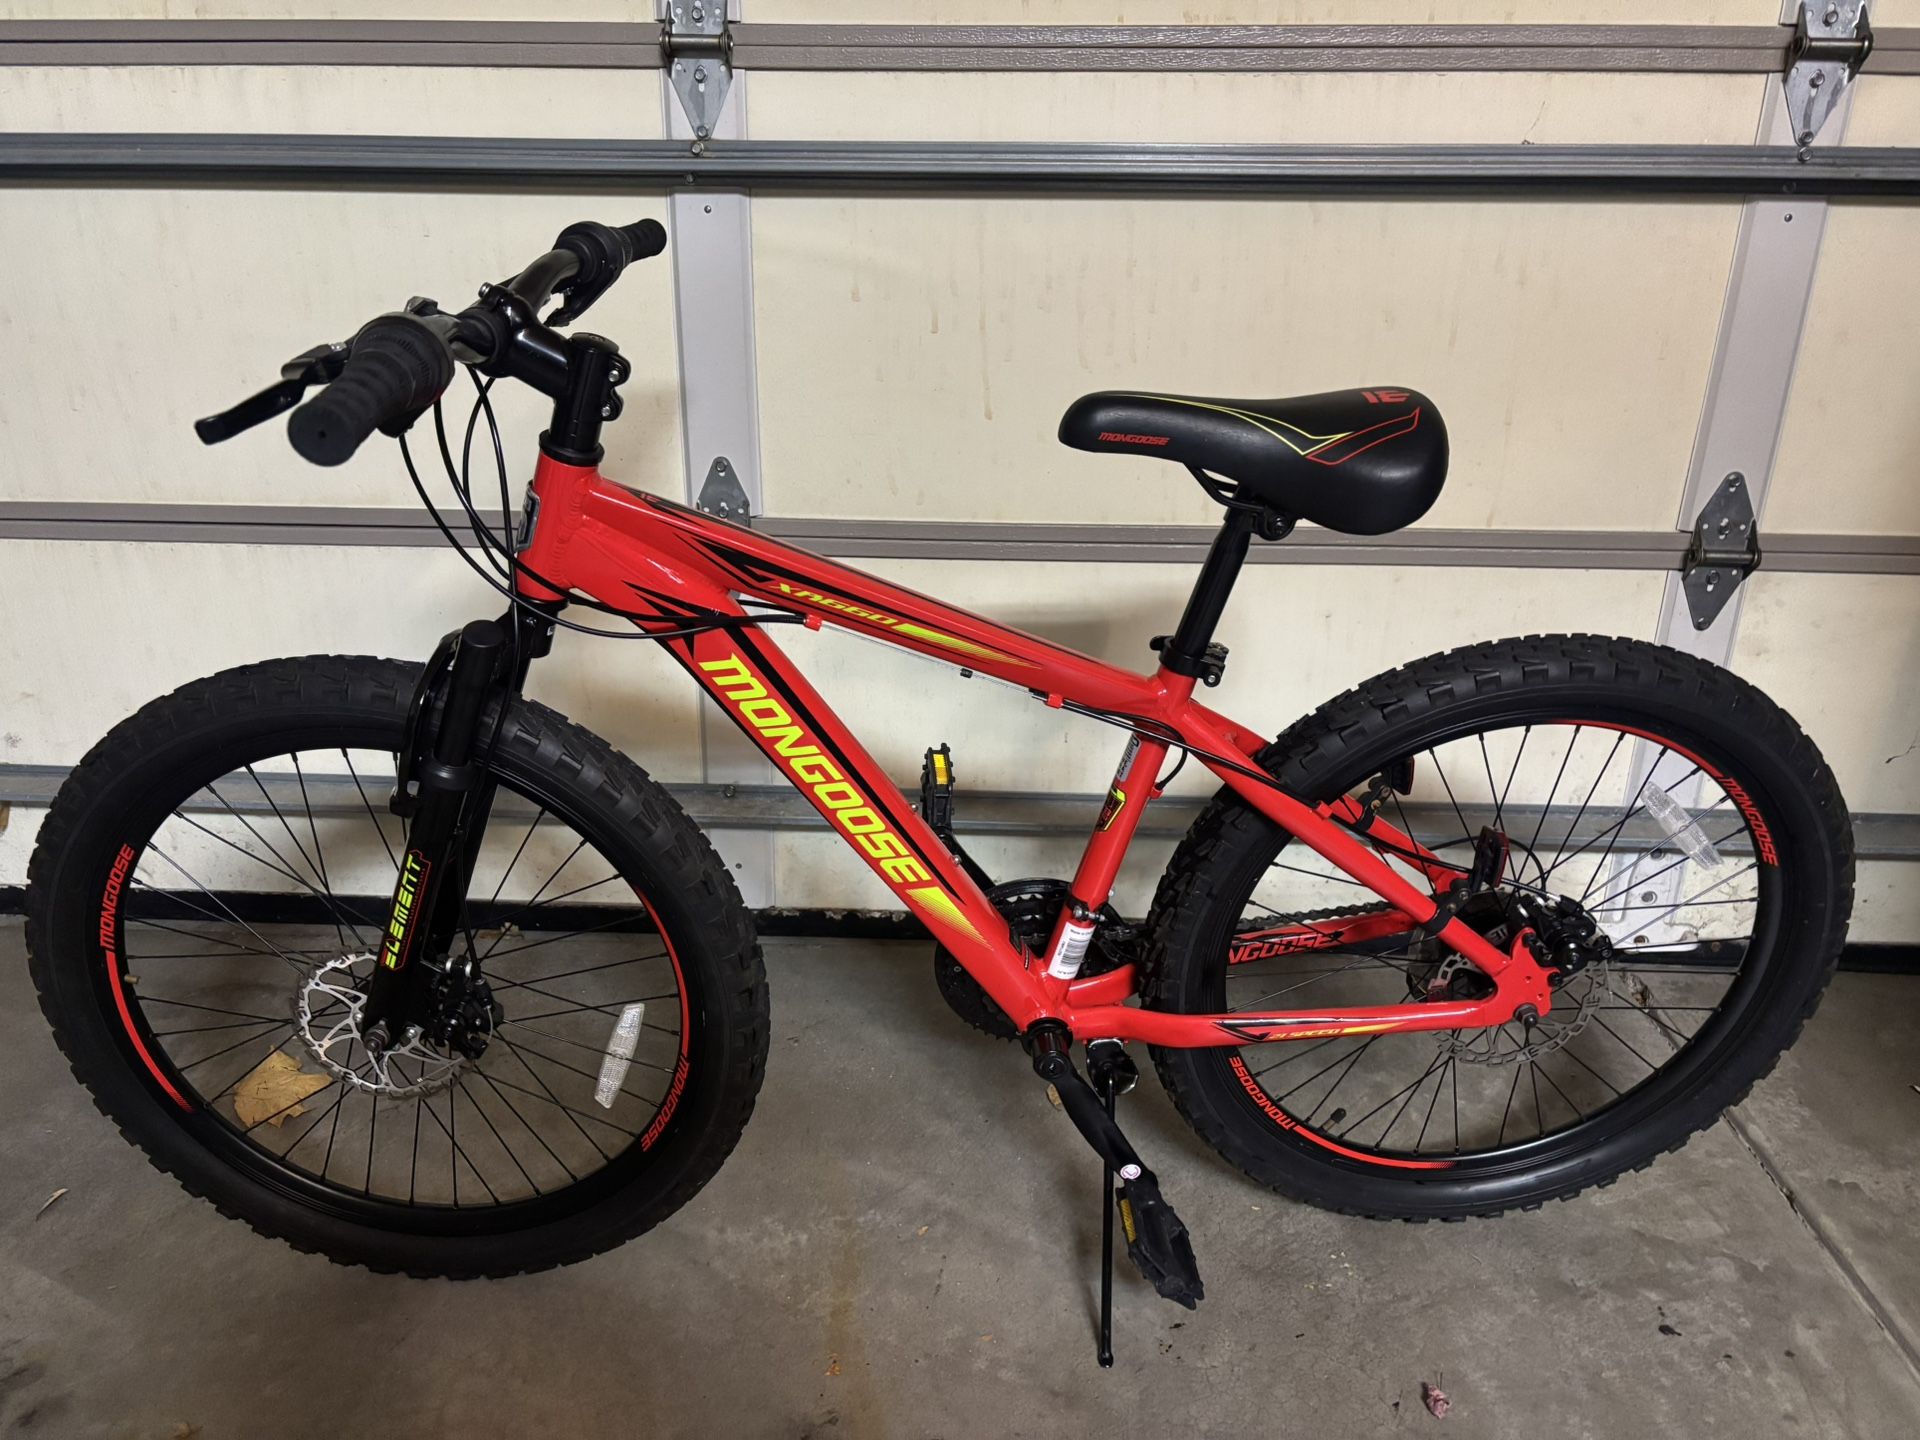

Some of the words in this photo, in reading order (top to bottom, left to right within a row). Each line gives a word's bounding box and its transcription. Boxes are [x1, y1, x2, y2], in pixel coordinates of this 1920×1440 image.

[1098, 432, 1169, 445] MONGOOSE
[698, 652, 932, 883] MONGOOSE
[1719, 778, 1779, 867] MONGOOSE
[100, 843, 135, 950] MONGOOSE
[381, 853, 421, 969] ELEMENT
[1228, 935, 1336, 965] NGOOSE
[640, 1055, 690, 1152] MONGOOSE
[1228, 1056, 1296, 1131] MONGOOSE
